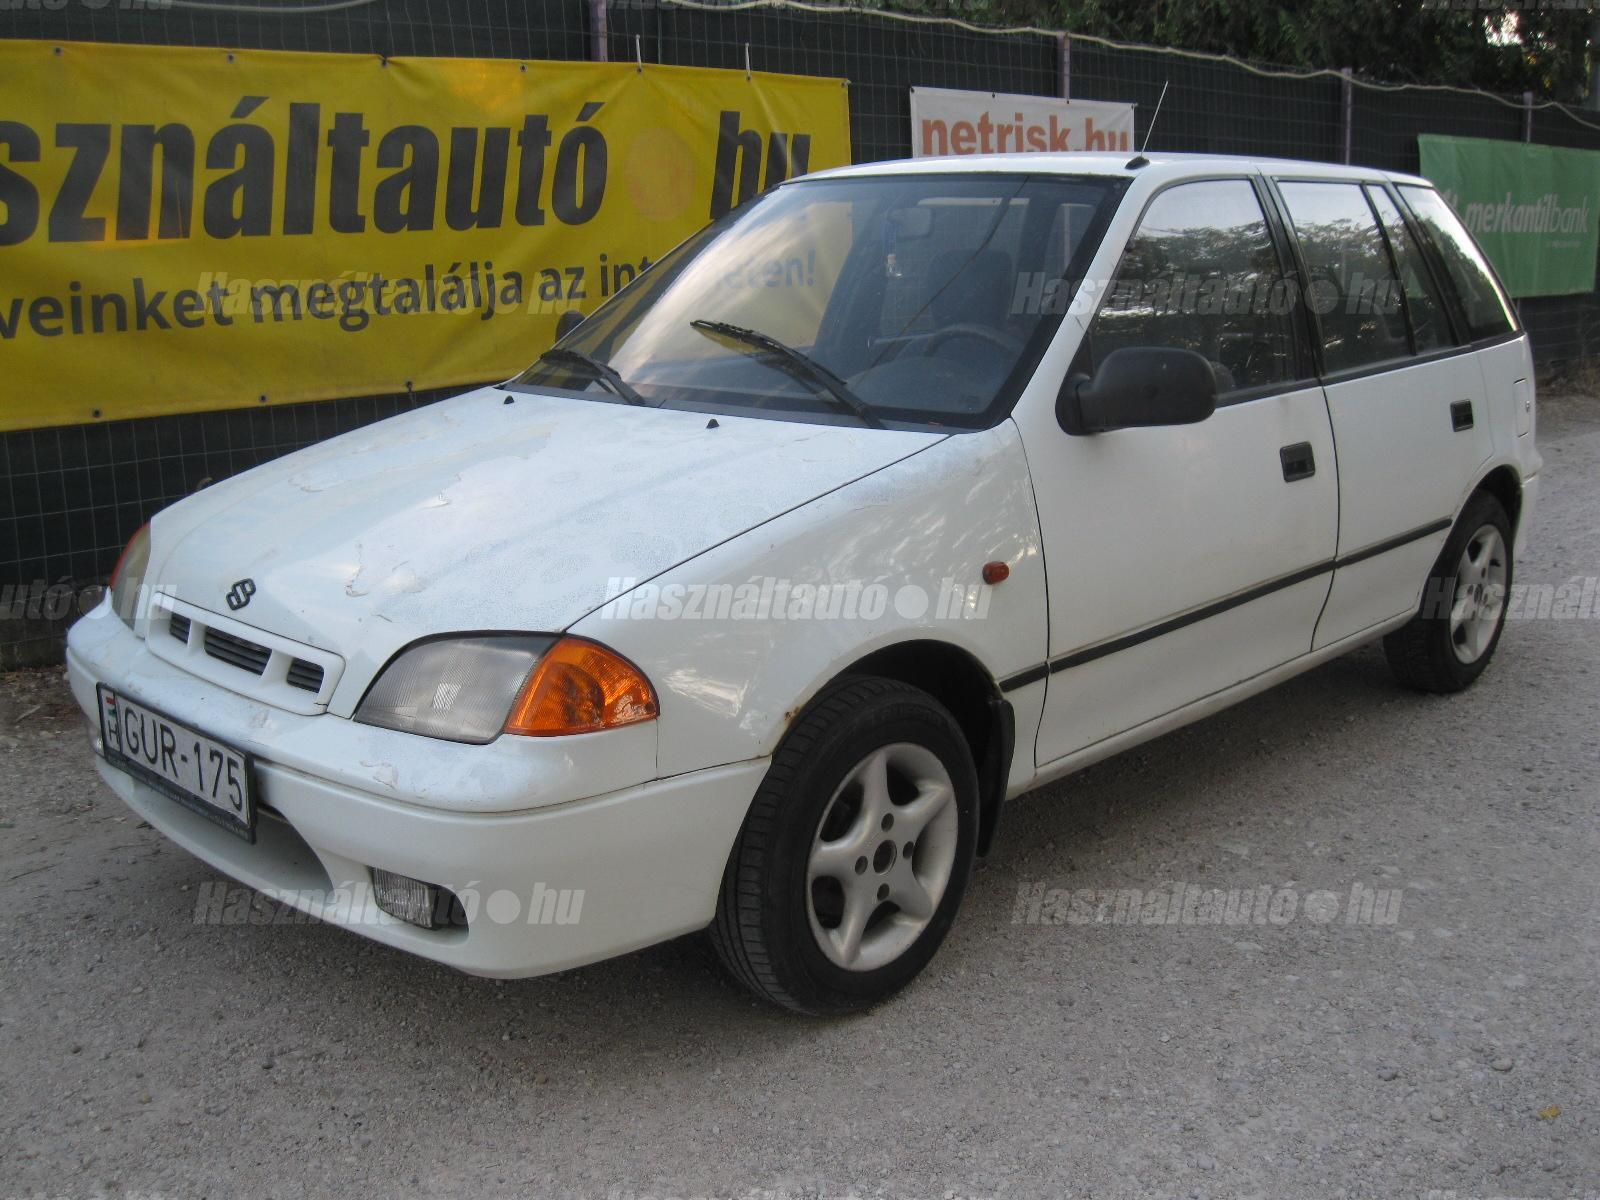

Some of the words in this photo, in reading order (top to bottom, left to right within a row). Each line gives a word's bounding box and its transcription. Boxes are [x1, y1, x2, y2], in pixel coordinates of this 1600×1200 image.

[921, 112, 1128, 155] netrisk.hu
[1465, 191, 1590, 233] merkantilbank
[250, 261, 522, 332] megtalálja
[538, 266, 587, 302] az
[107, 719, 120, 745] H
[124, 706, 243, 813] GUR-175
